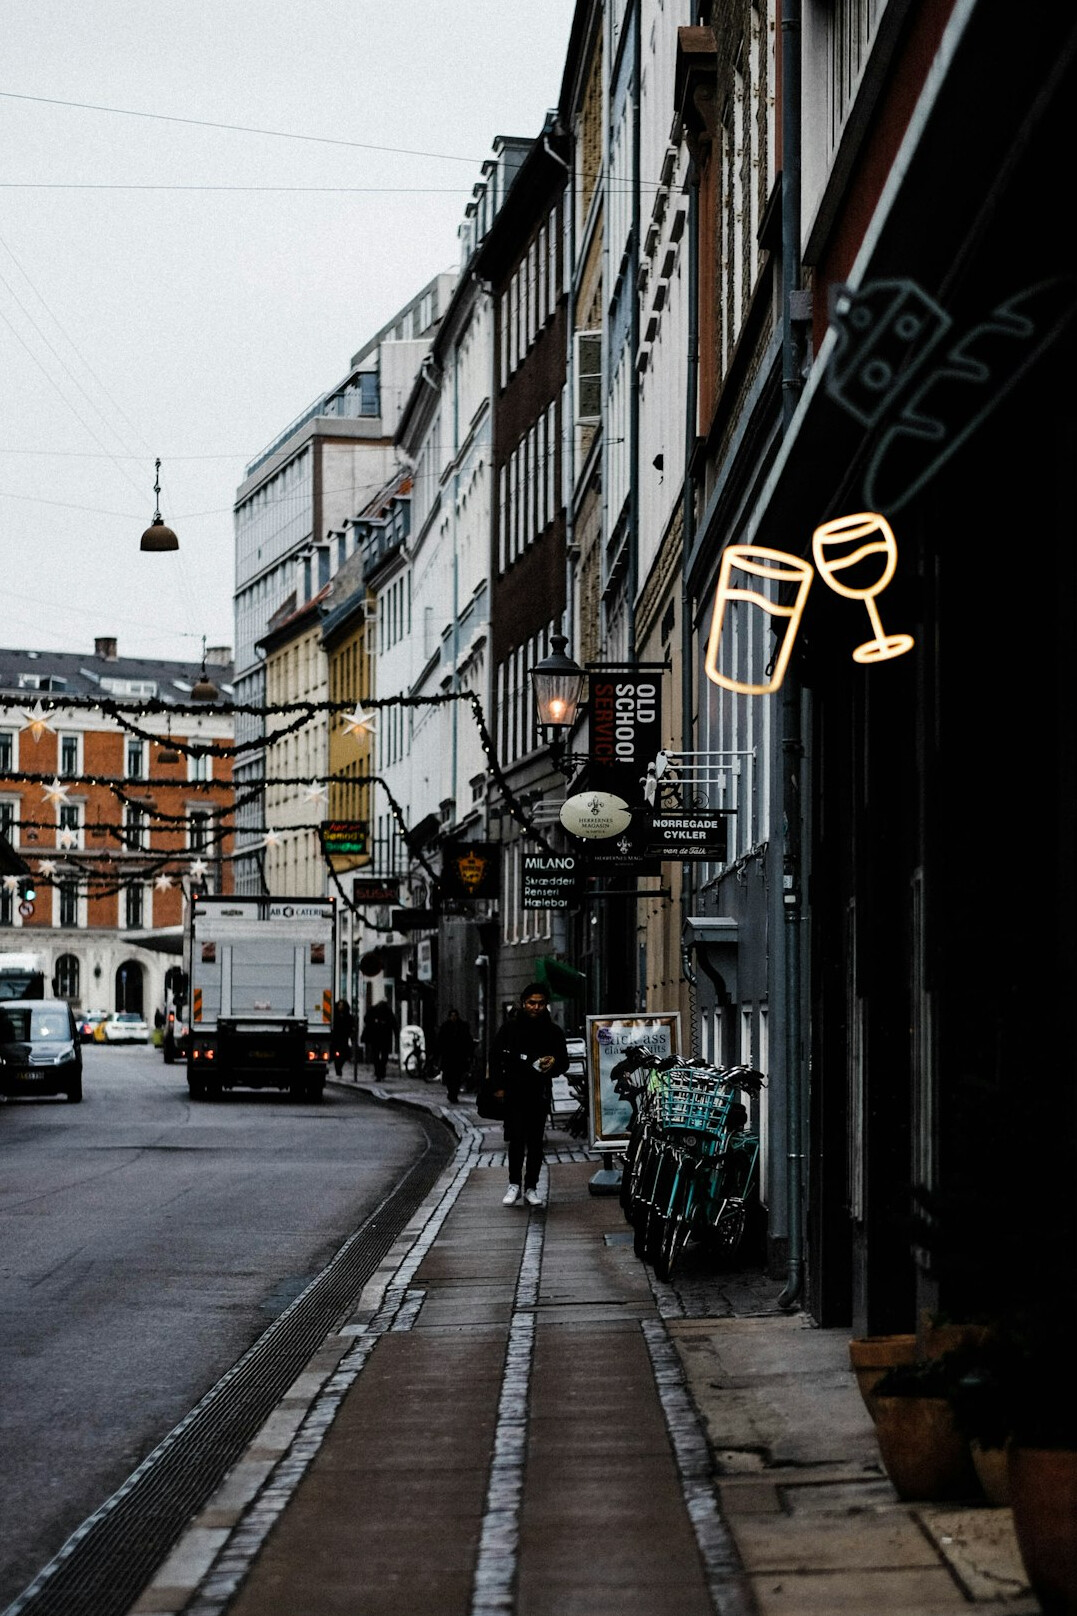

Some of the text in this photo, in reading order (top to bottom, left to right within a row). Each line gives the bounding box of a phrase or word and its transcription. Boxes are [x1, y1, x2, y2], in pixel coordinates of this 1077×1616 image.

[636, 684, 656, 723] OLD
[652, 819, 718, 828] NØRREGADE
[663, 830, 707, 839] CYKLER
[679, 847, 688, 855] de
[525, 857, 575, 869] MILANO
[525, 875, 575, 886] Skrædderi
[524, 886, 559, 896] Renseri
[524, 897, 568, 907] Hælebar
[643, 1033, 667, 1045] ass
